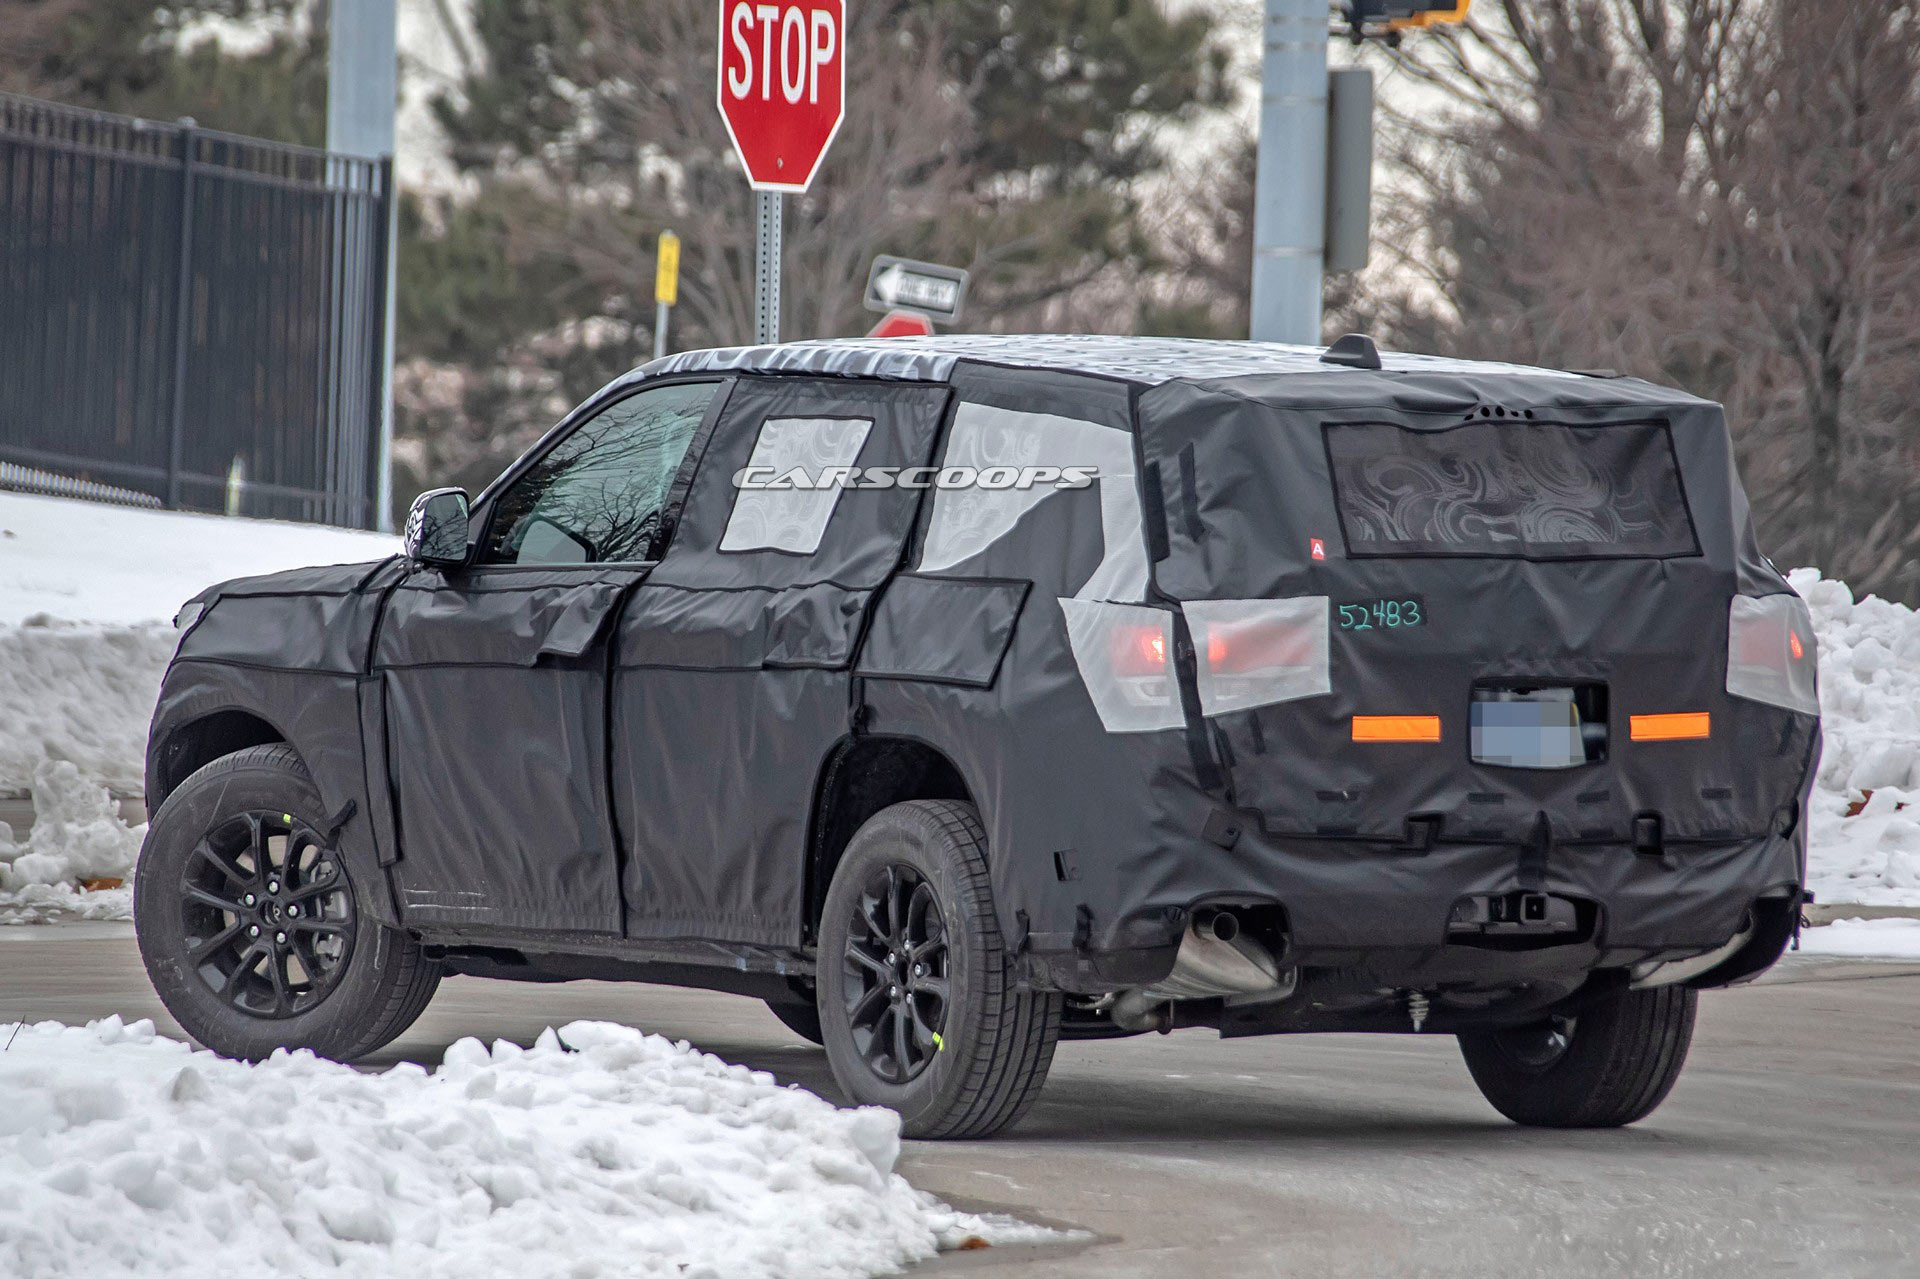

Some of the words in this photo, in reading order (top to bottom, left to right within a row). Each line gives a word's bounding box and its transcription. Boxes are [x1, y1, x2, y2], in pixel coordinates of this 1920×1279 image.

[728, 1, 836, 105] STOP
[1312, 543, 1324, 556] A
[1339, 600, 1421, 630] 52483
